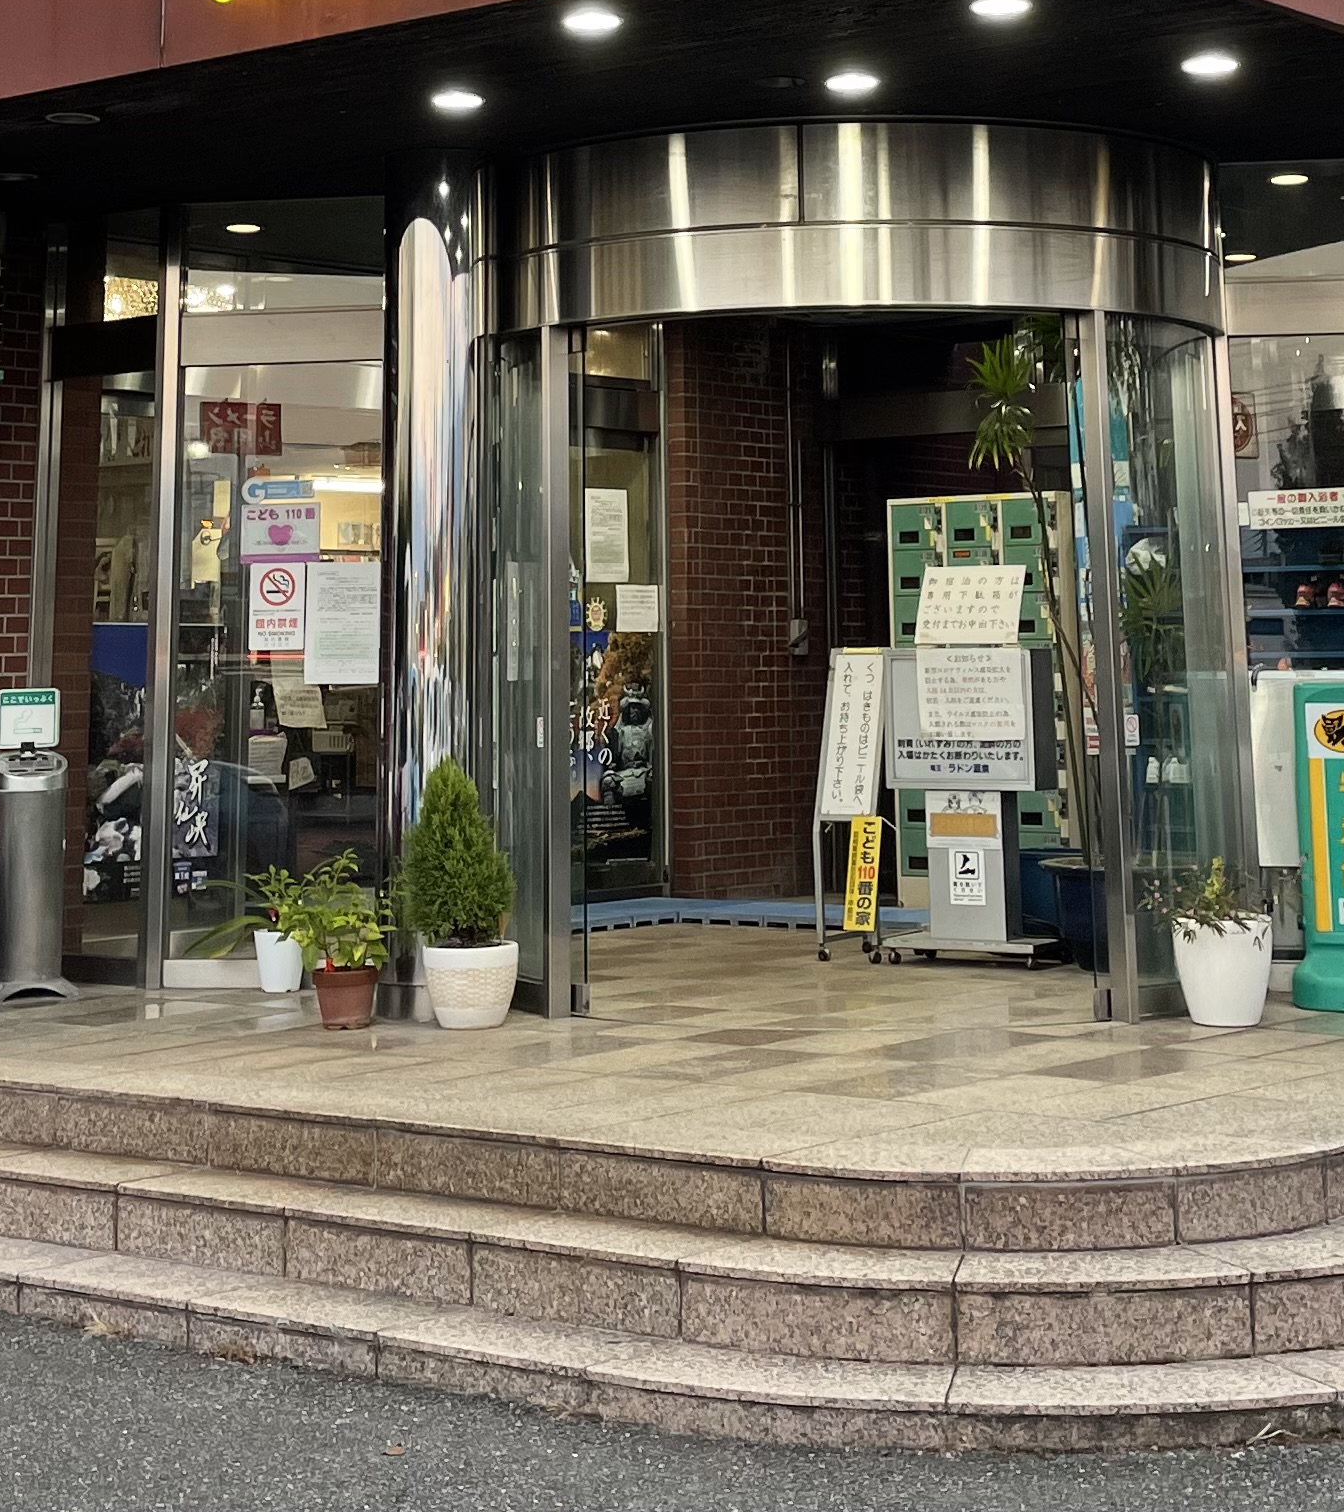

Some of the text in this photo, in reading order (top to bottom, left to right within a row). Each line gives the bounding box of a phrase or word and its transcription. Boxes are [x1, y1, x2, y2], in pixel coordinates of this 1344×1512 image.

[247, 508, 280, 521] こども
[285, 509, 302, 519] 110
[2, 694, 53, 705] ここでいっぷく
[174, 758, 209, 848] 昇仙峡
